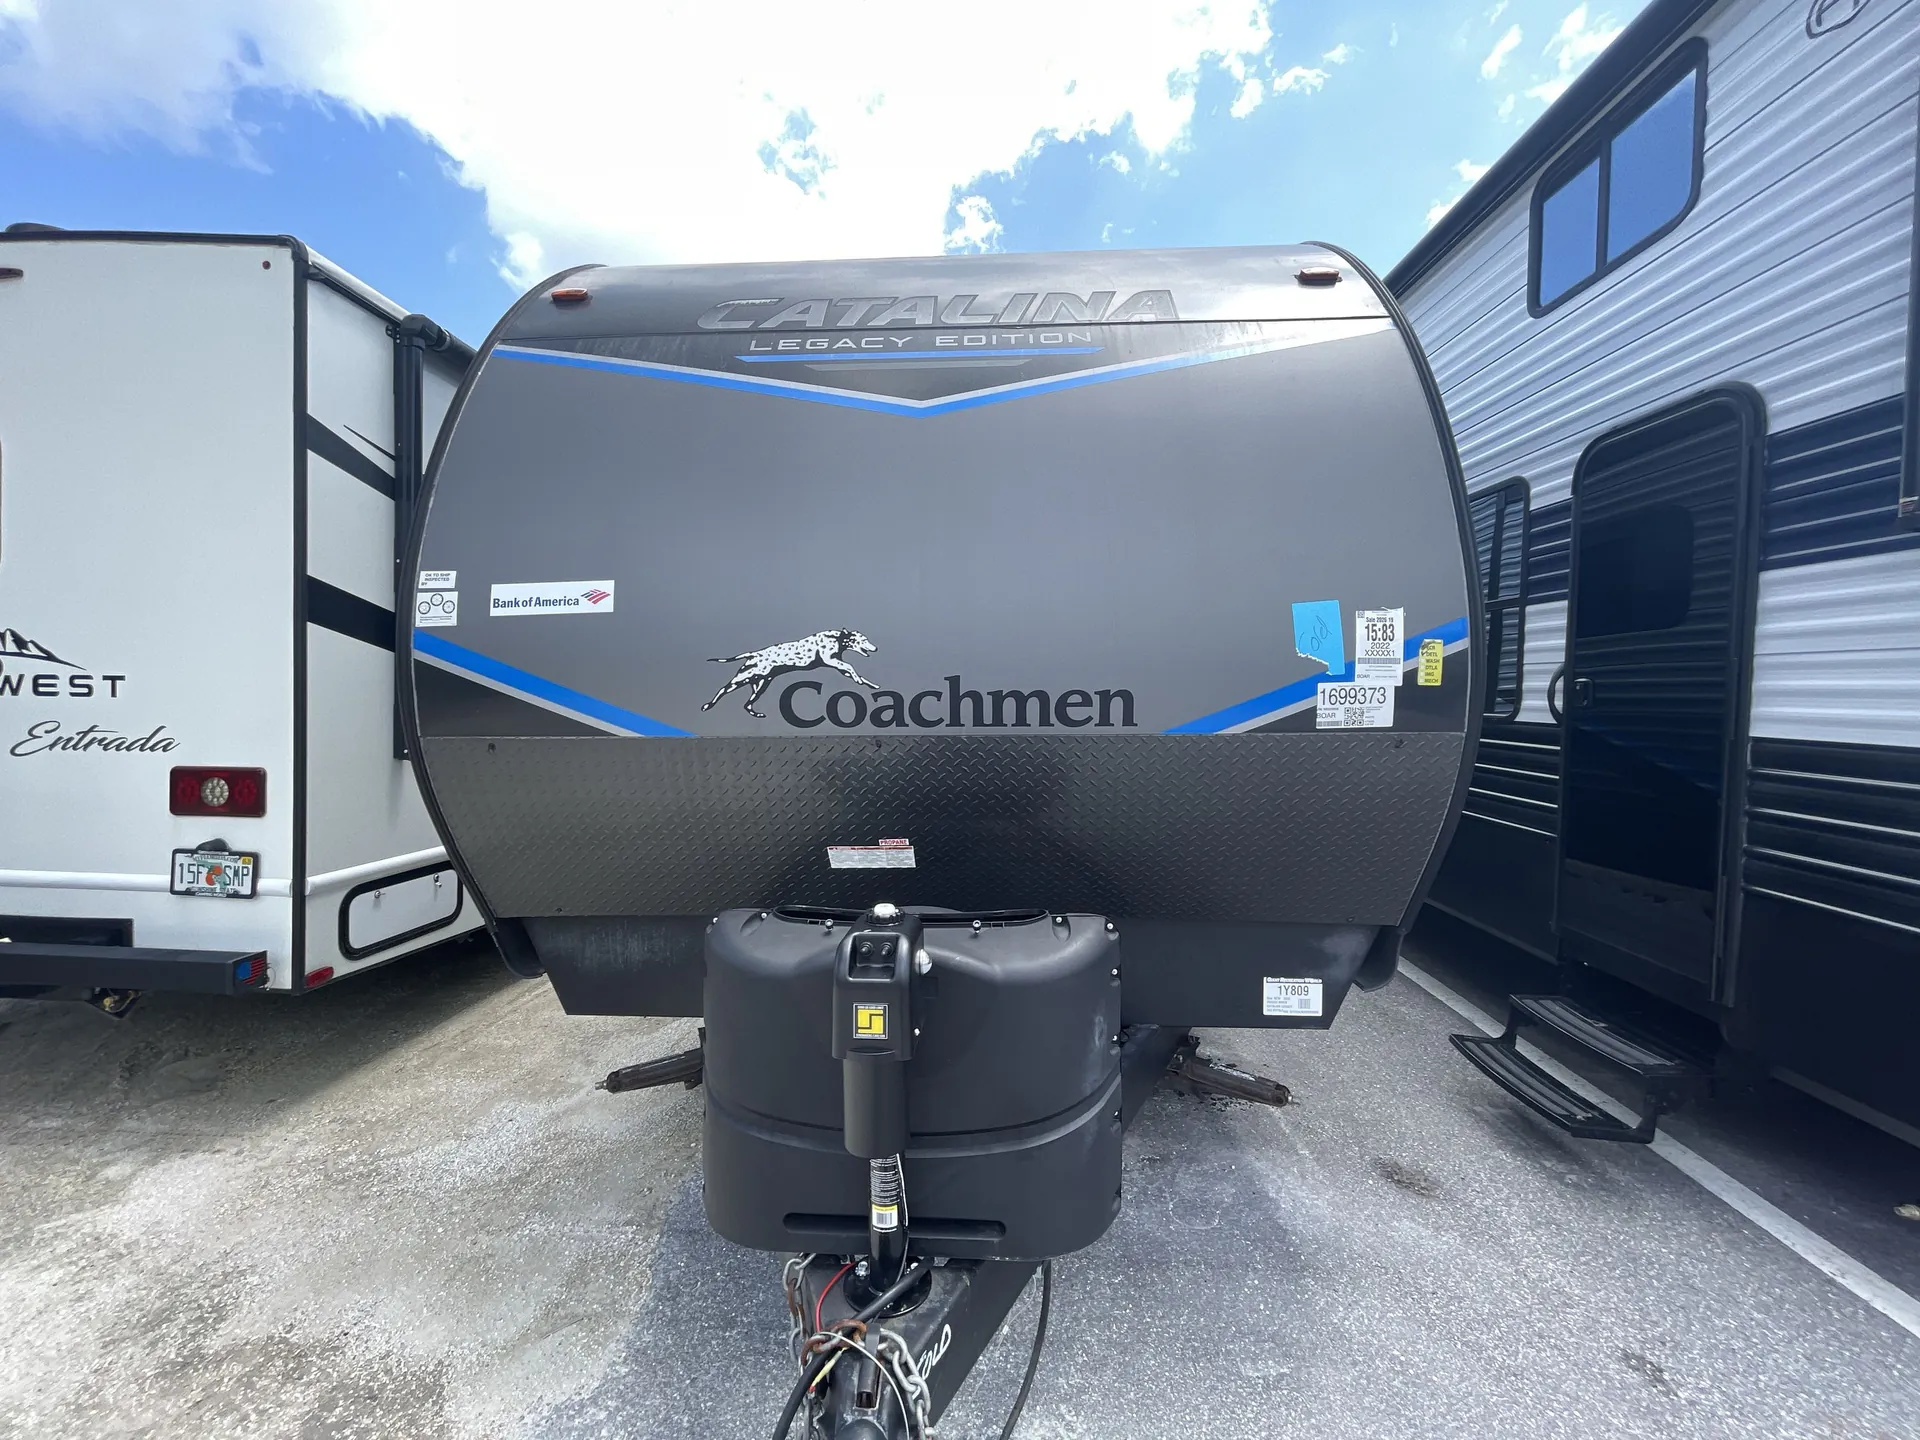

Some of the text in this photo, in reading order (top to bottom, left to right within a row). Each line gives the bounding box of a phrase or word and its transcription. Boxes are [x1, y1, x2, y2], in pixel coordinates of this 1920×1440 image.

[697, 289, 1179, 329] CATALINA
[750, 331, 1092, 351] LEGACY EDITION
[493, 595, 580, 609] Bank of America
[1365, 623, 1395, 641] 15:83
[778, 675, 1138, 729] Coachmen
[1319, 686, 1387, 706] 1699373
[10, 720, 181, 757] Entrada
[178, 862, 250, 887] 15F SMP
[1277, 985, 1309, 996] 1Y809
